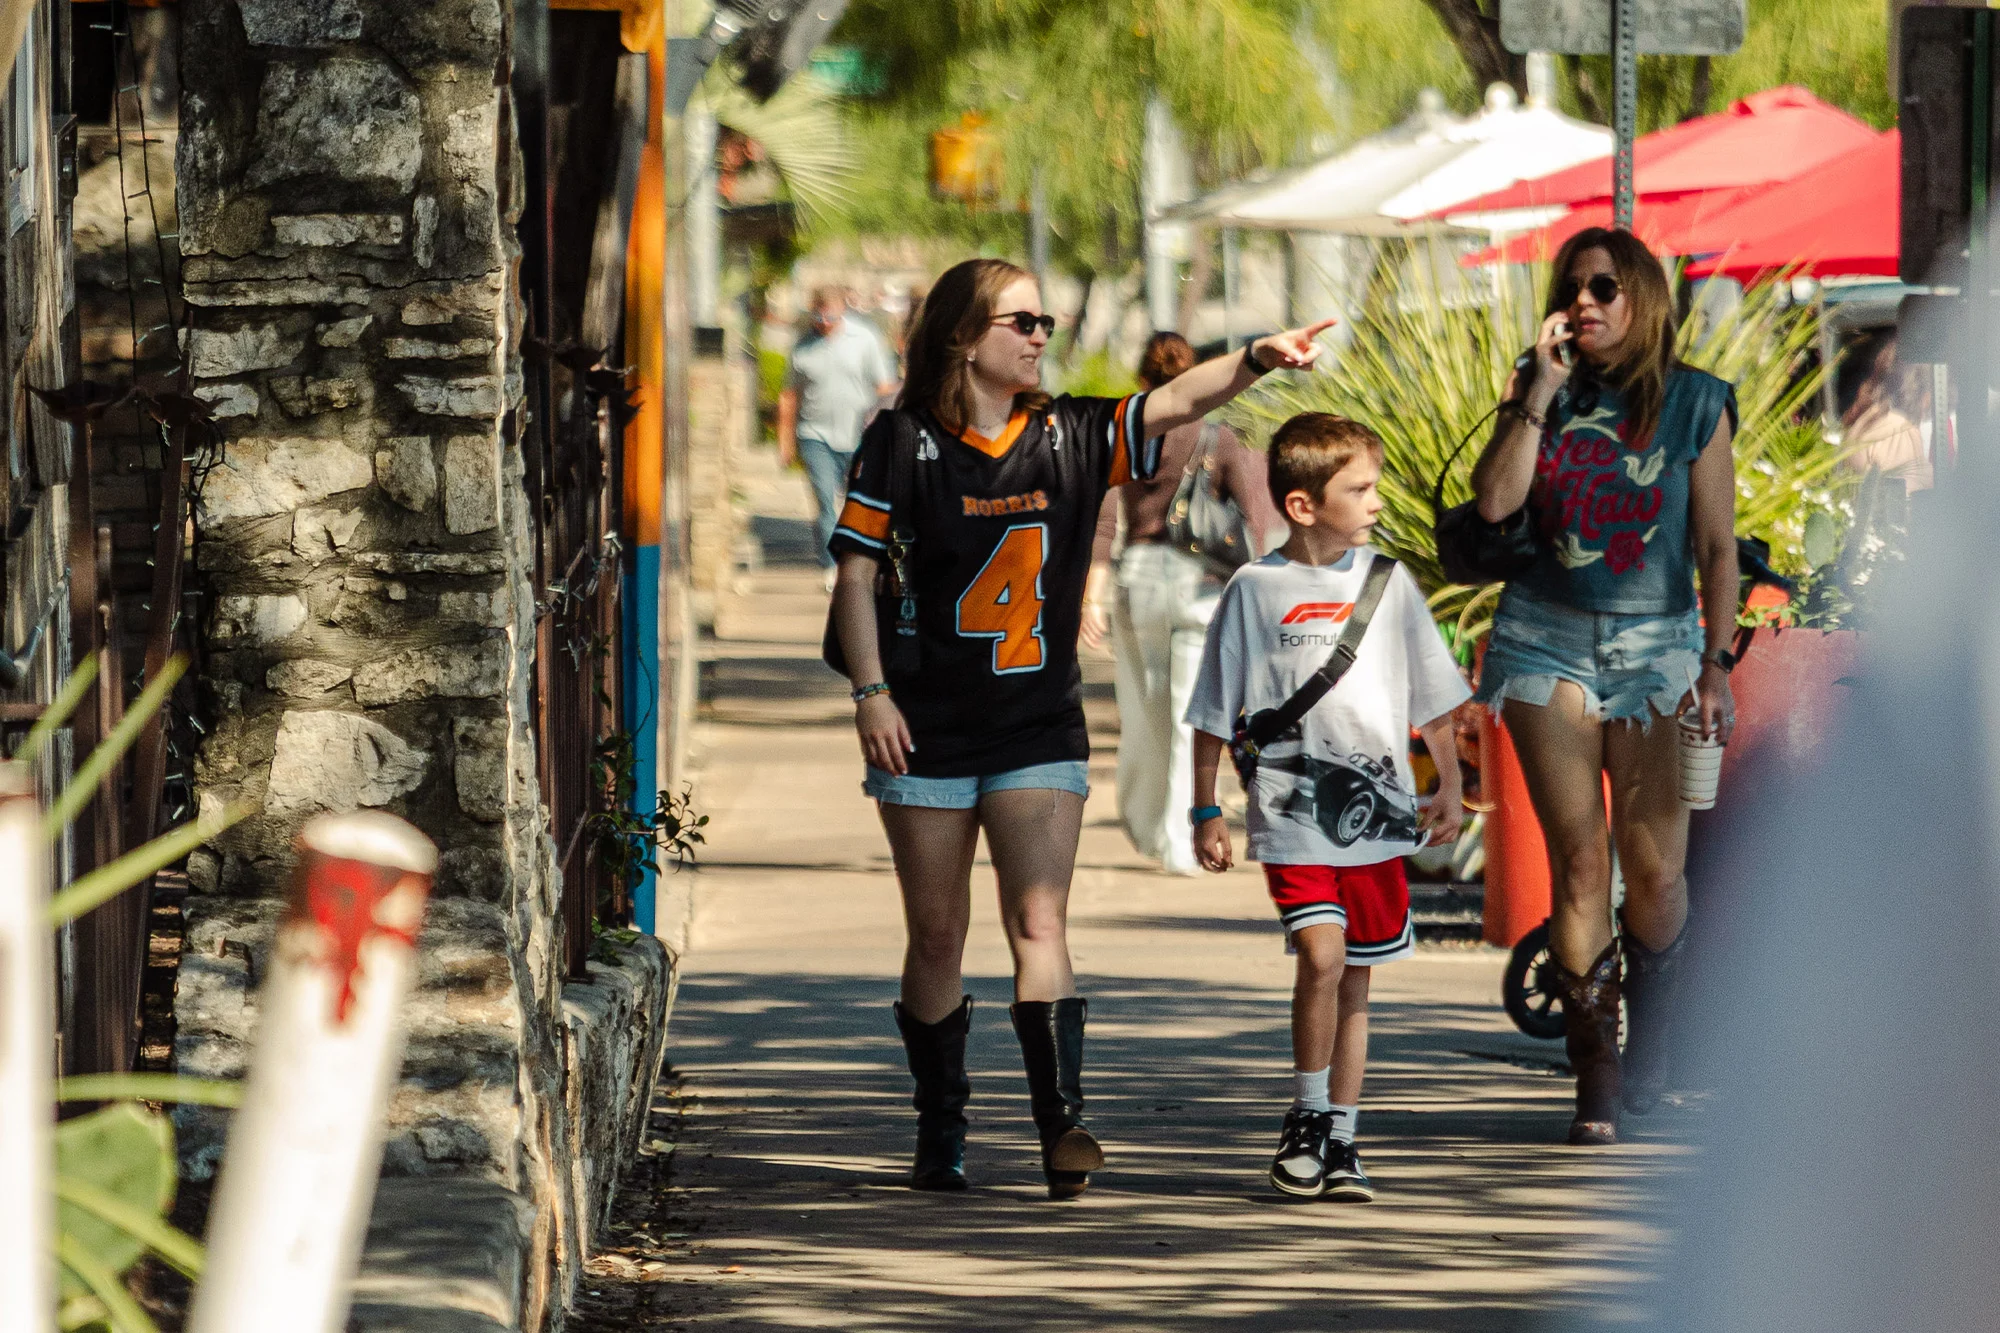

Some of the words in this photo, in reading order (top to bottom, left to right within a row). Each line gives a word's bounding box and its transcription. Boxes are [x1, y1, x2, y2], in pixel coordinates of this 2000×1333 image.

[1537, 430, 1618, 502] Yee
[961, 490, 1048, 516] NORRIS
[1557, 468, 1663, 540] Haw
[956, 523, 1050, 676] 4
[1280, 632, 1341, 647] Formul
